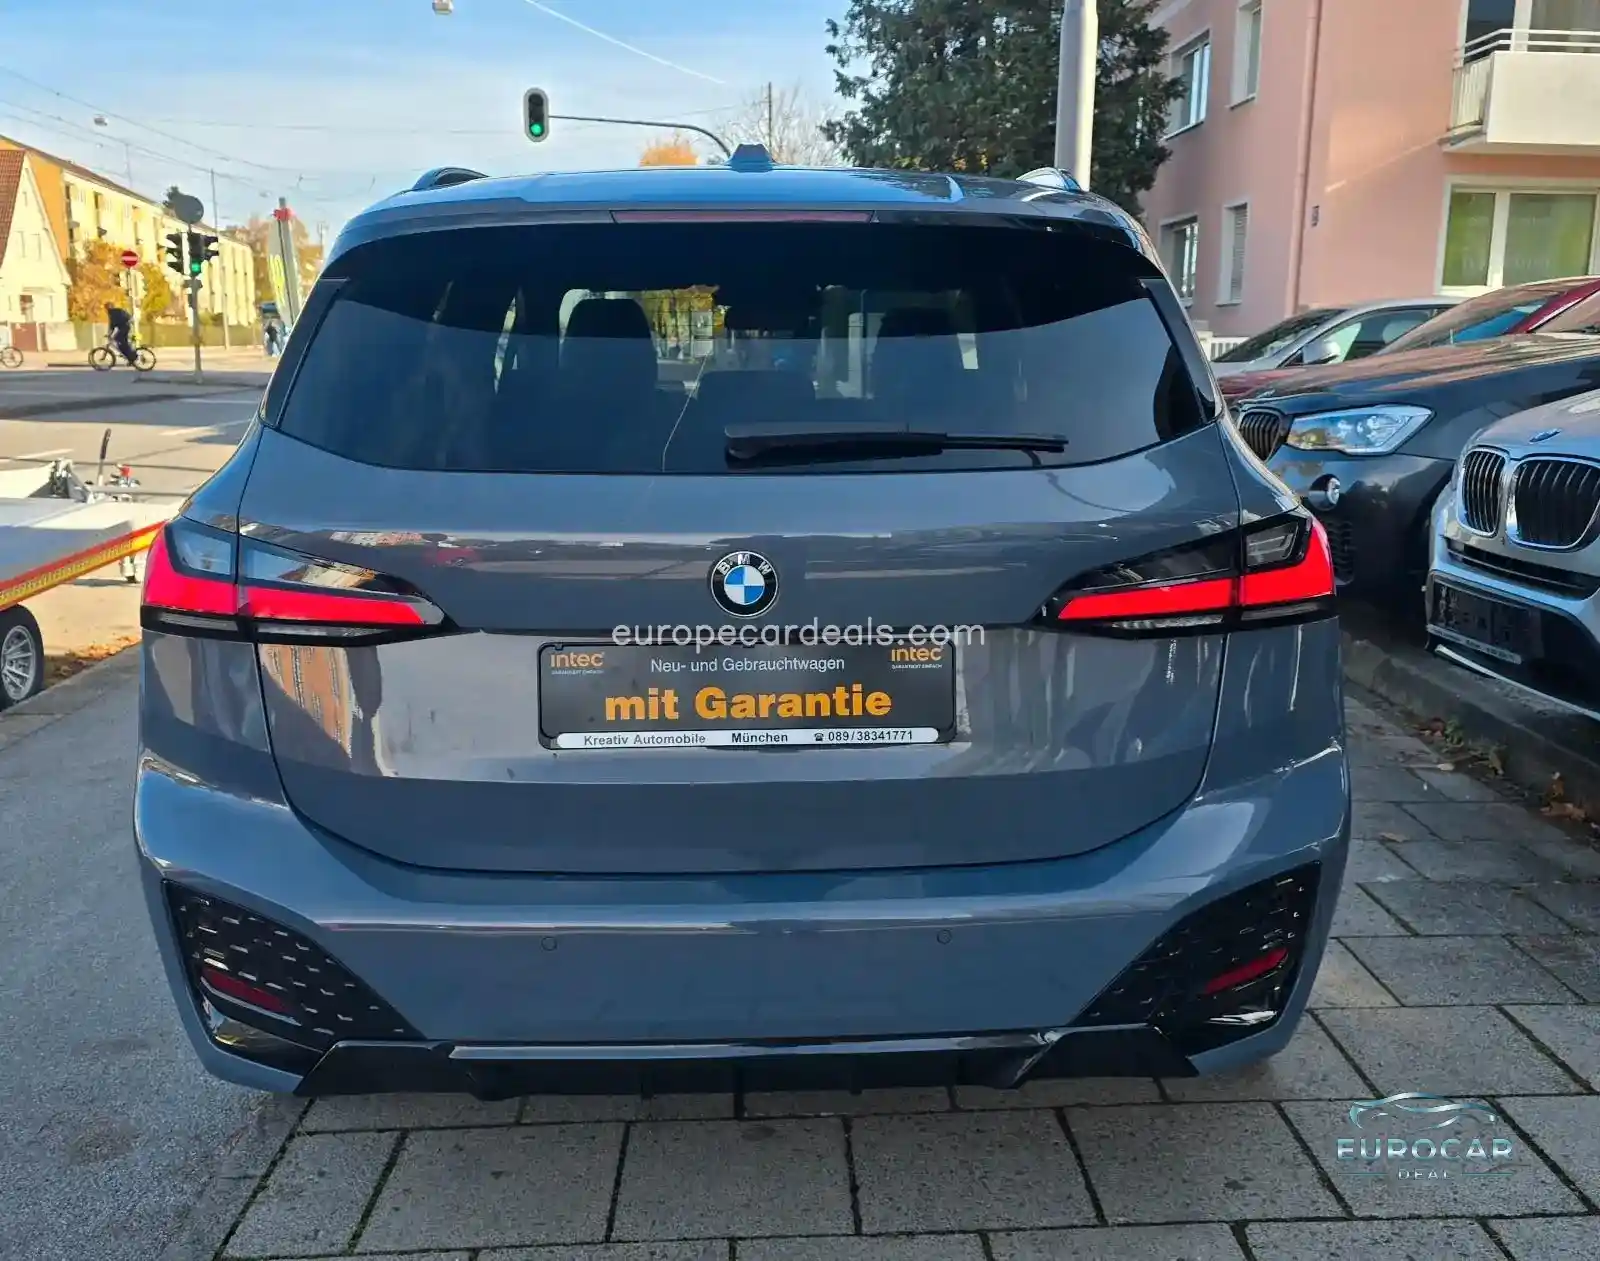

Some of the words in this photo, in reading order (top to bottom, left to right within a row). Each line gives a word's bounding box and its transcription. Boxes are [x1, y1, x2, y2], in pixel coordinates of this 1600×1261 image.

[717, 553, 772, 576] BMW
[550, 652, 604, 668] intec
[891, 646, 943, 662] intec
[650, 658, 686, 673] Neu-
[691, 658, 718, 672] und
[722, 656, 845, 673] Gebrauchtwagen
[605, 687, 679, 721] mit
[694, 683, 892, 720] Garantie
[583, 735, 629, 746] Kreativ
[633, 733, 706, 745] Automobile
[731, 732, 788, 743] München
[827, 729, 913, 742] 089/38341771
